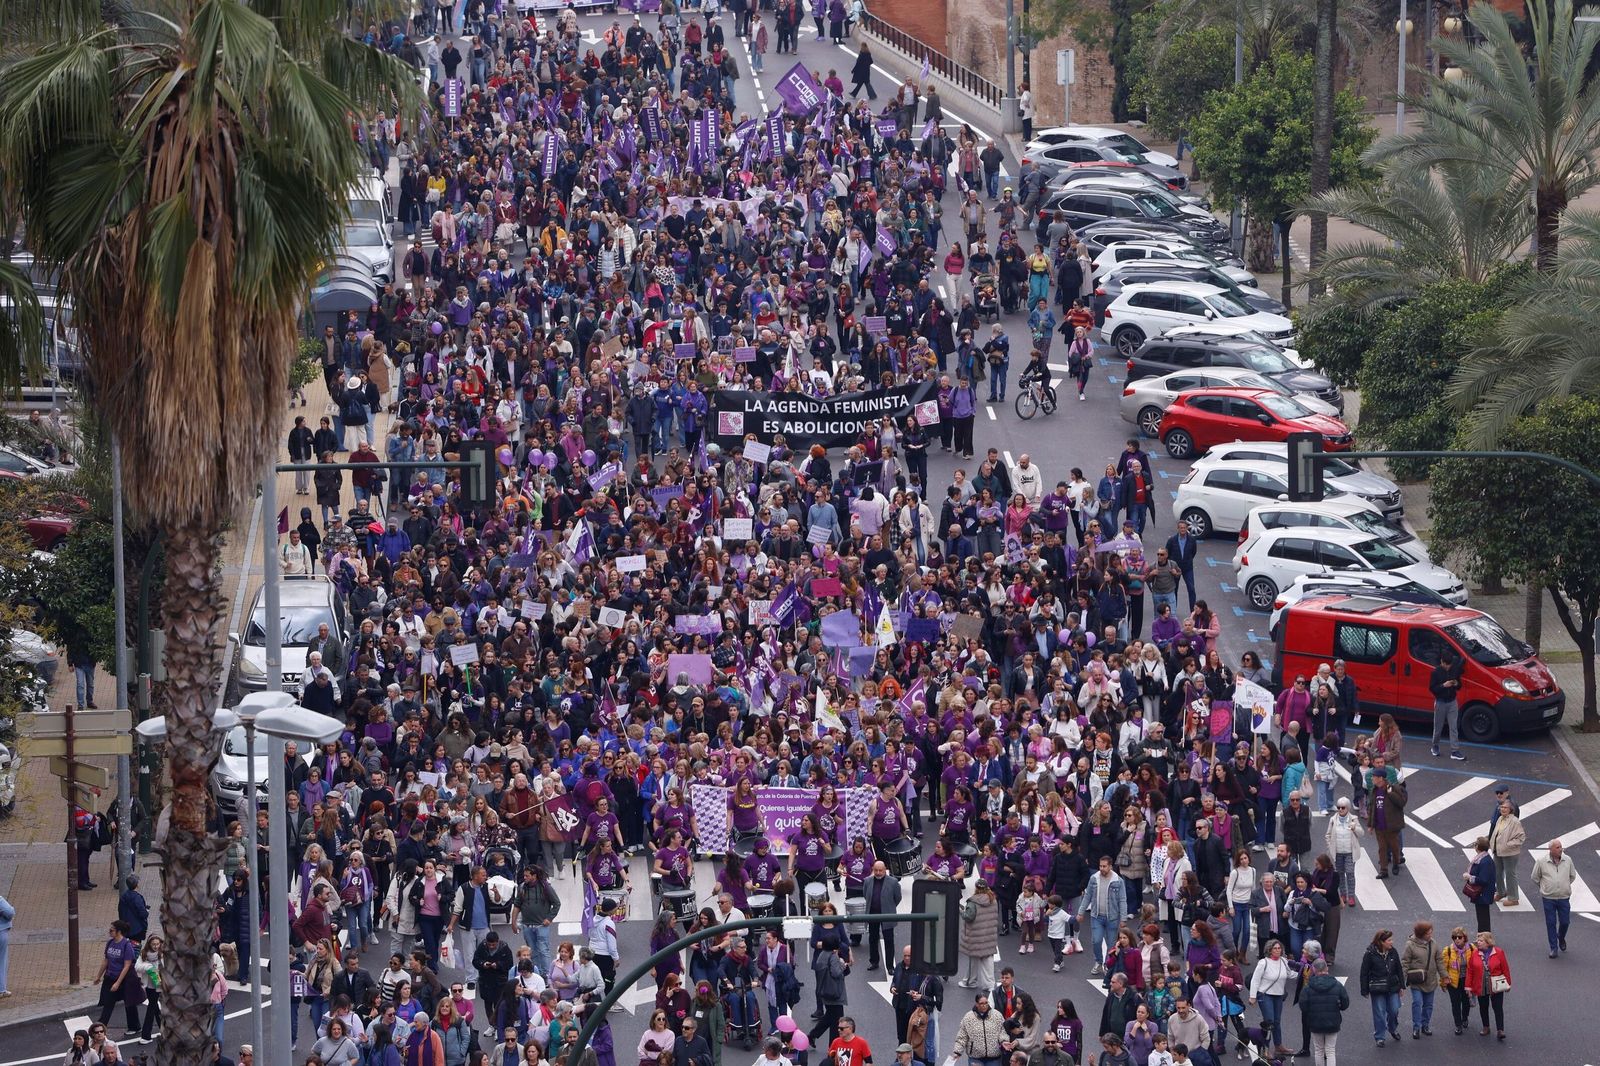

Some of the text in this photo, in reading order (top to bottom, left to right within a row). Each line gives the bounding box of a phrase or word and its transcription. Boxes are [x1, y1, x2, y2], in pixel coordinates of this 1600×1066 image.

[744, 399, 764, 413] LA
[766, 400, 830, 414] AGENDA
[834, 394, 910, 414] FEMINISTA
[763, 420, 780, 434] ES
[783, 416, 898, 435] ABOLICIONS
[760, 804, 785, 813] Quieres
